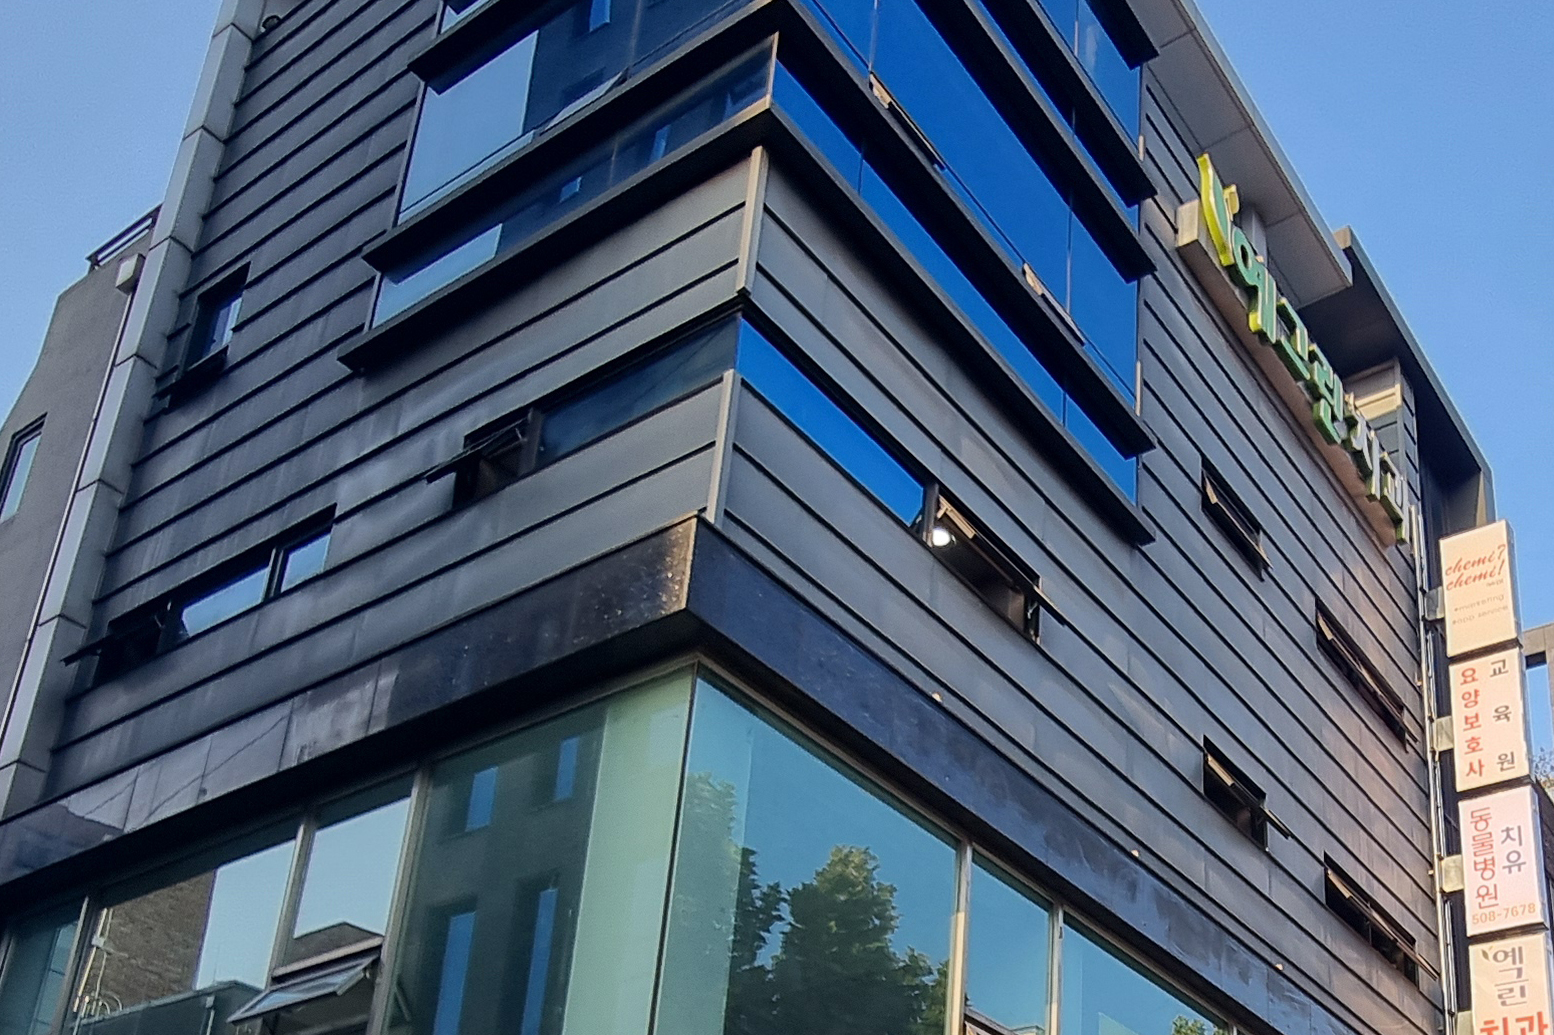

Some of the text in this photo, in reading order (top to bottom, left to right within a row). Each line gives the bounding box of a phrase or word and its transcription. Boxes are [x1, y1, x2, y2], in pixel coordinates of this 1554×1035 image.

[1445, 544, 1506, 576] chemi?
[1446, 559, 1505, 591] chemi!
[1460, 667, 1485, 777] 요양보호사
[1489, 659, 1516, 772] 교육원
[1470, 807, 1499, 910] 동물병원
[1500, 825, 1527, 874] 치유
[1472, 903, 1537, 925] 508-7678
[1492, 945, 1529, 1007] 예그린
